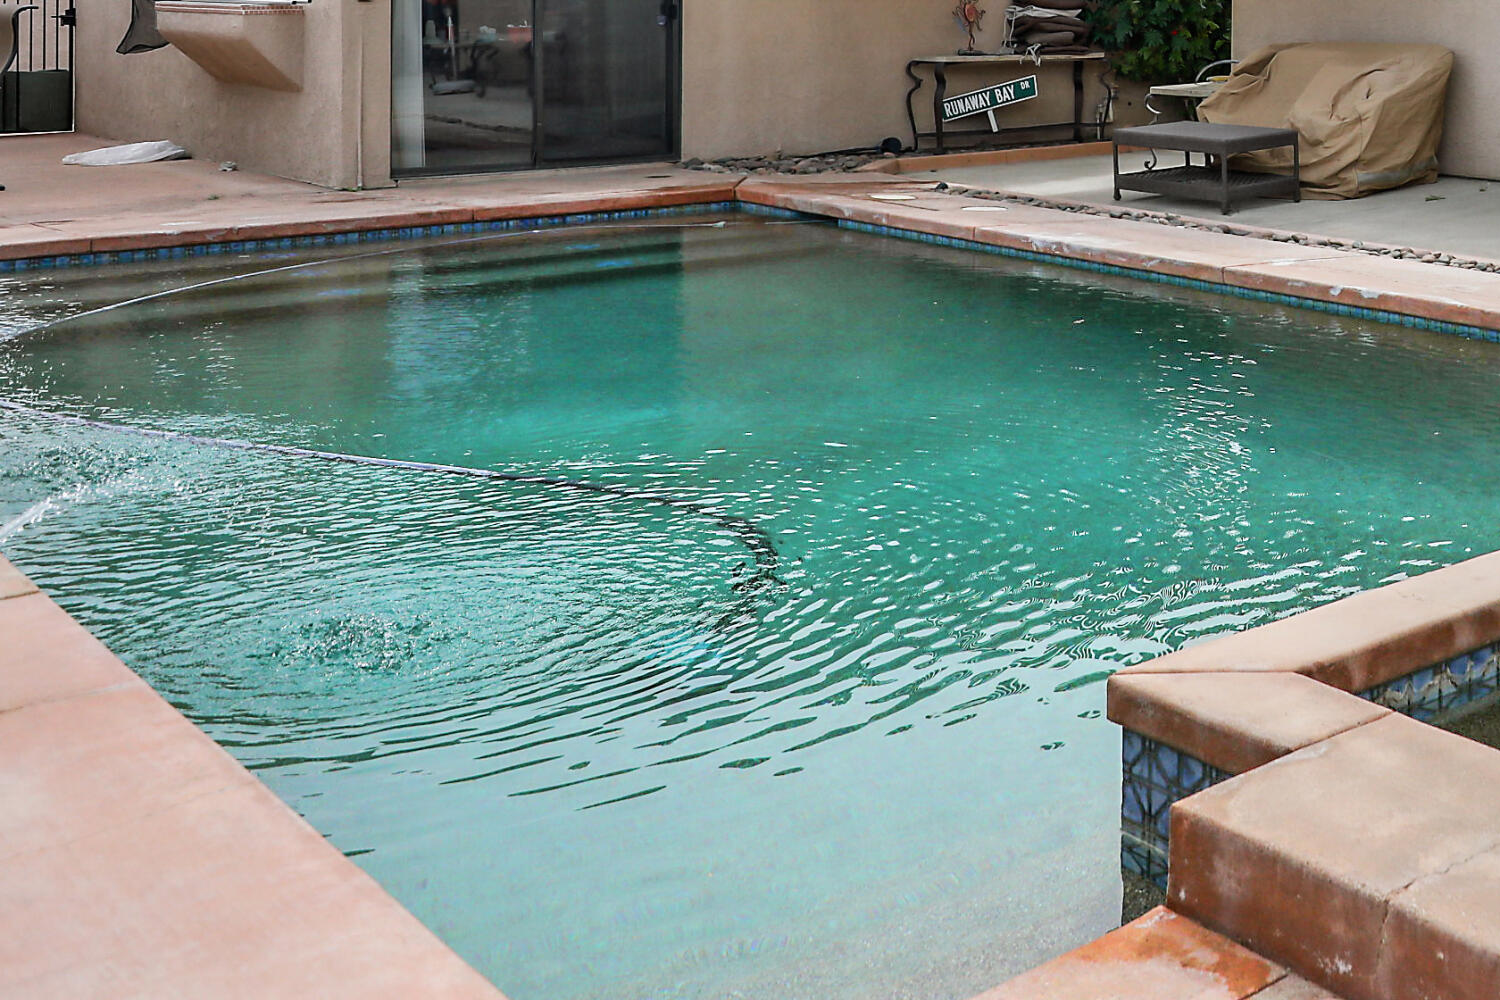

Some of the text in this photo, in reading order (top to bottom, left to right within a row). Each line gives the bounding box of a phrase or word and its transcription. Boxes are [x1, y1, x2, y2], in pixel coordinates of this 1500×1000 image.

[943, 80, 1031, 117] RUNAWAY BAY DR
